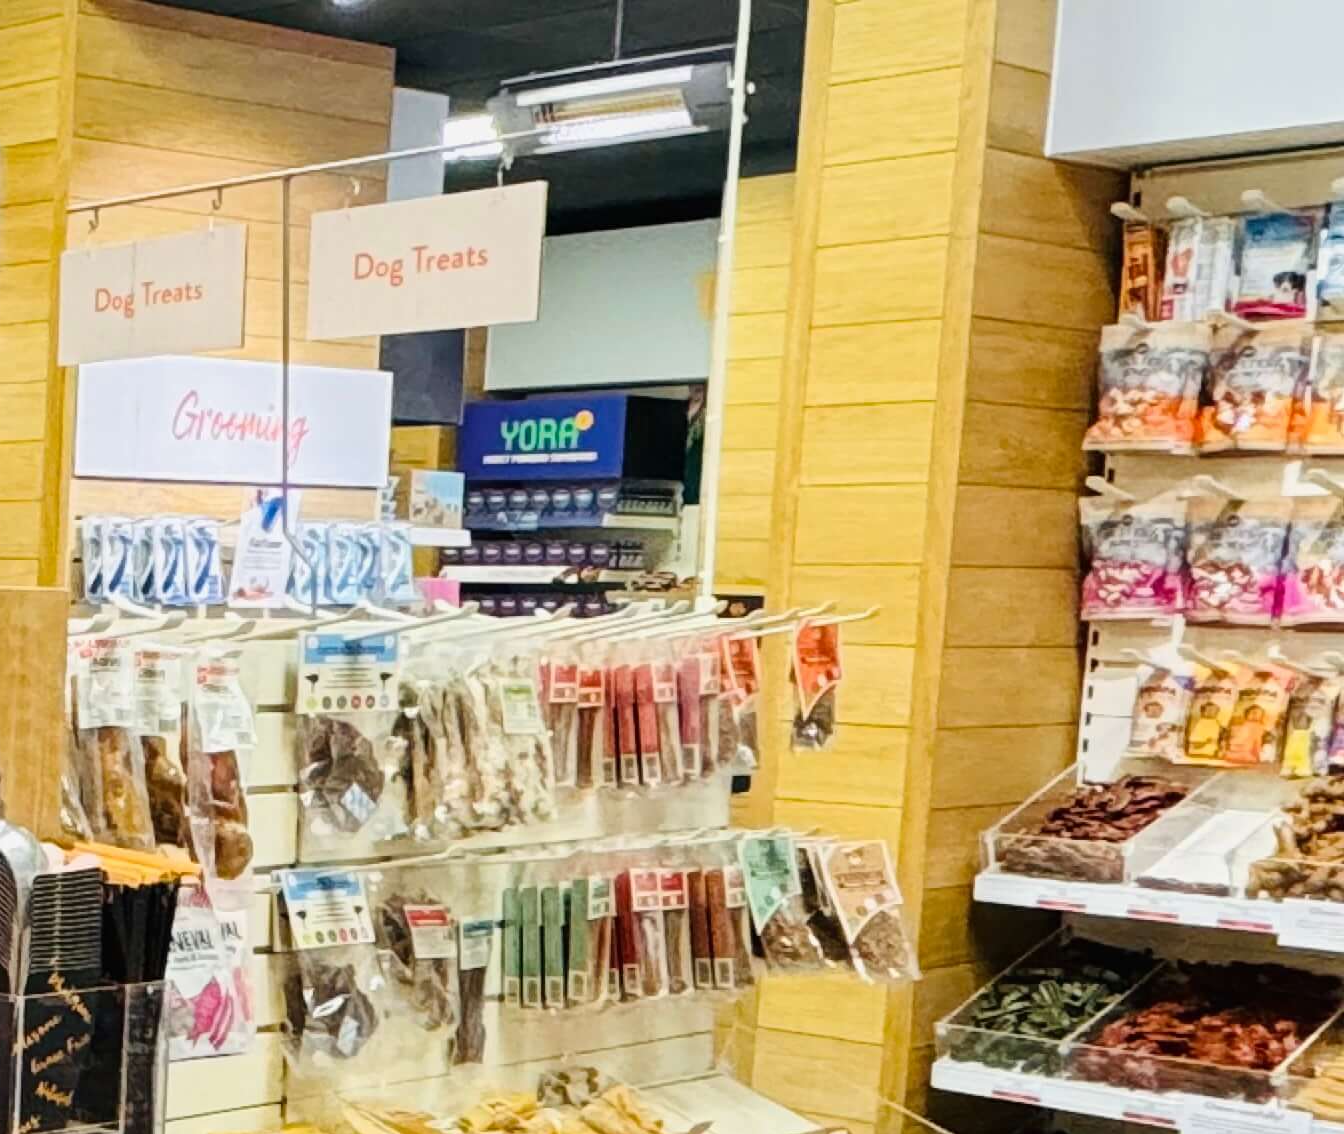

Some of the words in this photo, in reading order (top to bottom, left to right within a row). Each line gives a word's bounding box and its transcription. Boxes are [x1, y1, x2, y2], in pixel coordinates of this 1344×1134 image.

[354, 253, 405, 288] Dog
[412, 245, 489, 276] Treats
[94, 287, 136, 318] Dog
[142, 280, 203, 308] Treats
[171, 390, 311, 464] Grooming
[500, 417, 581, 451] YORA
